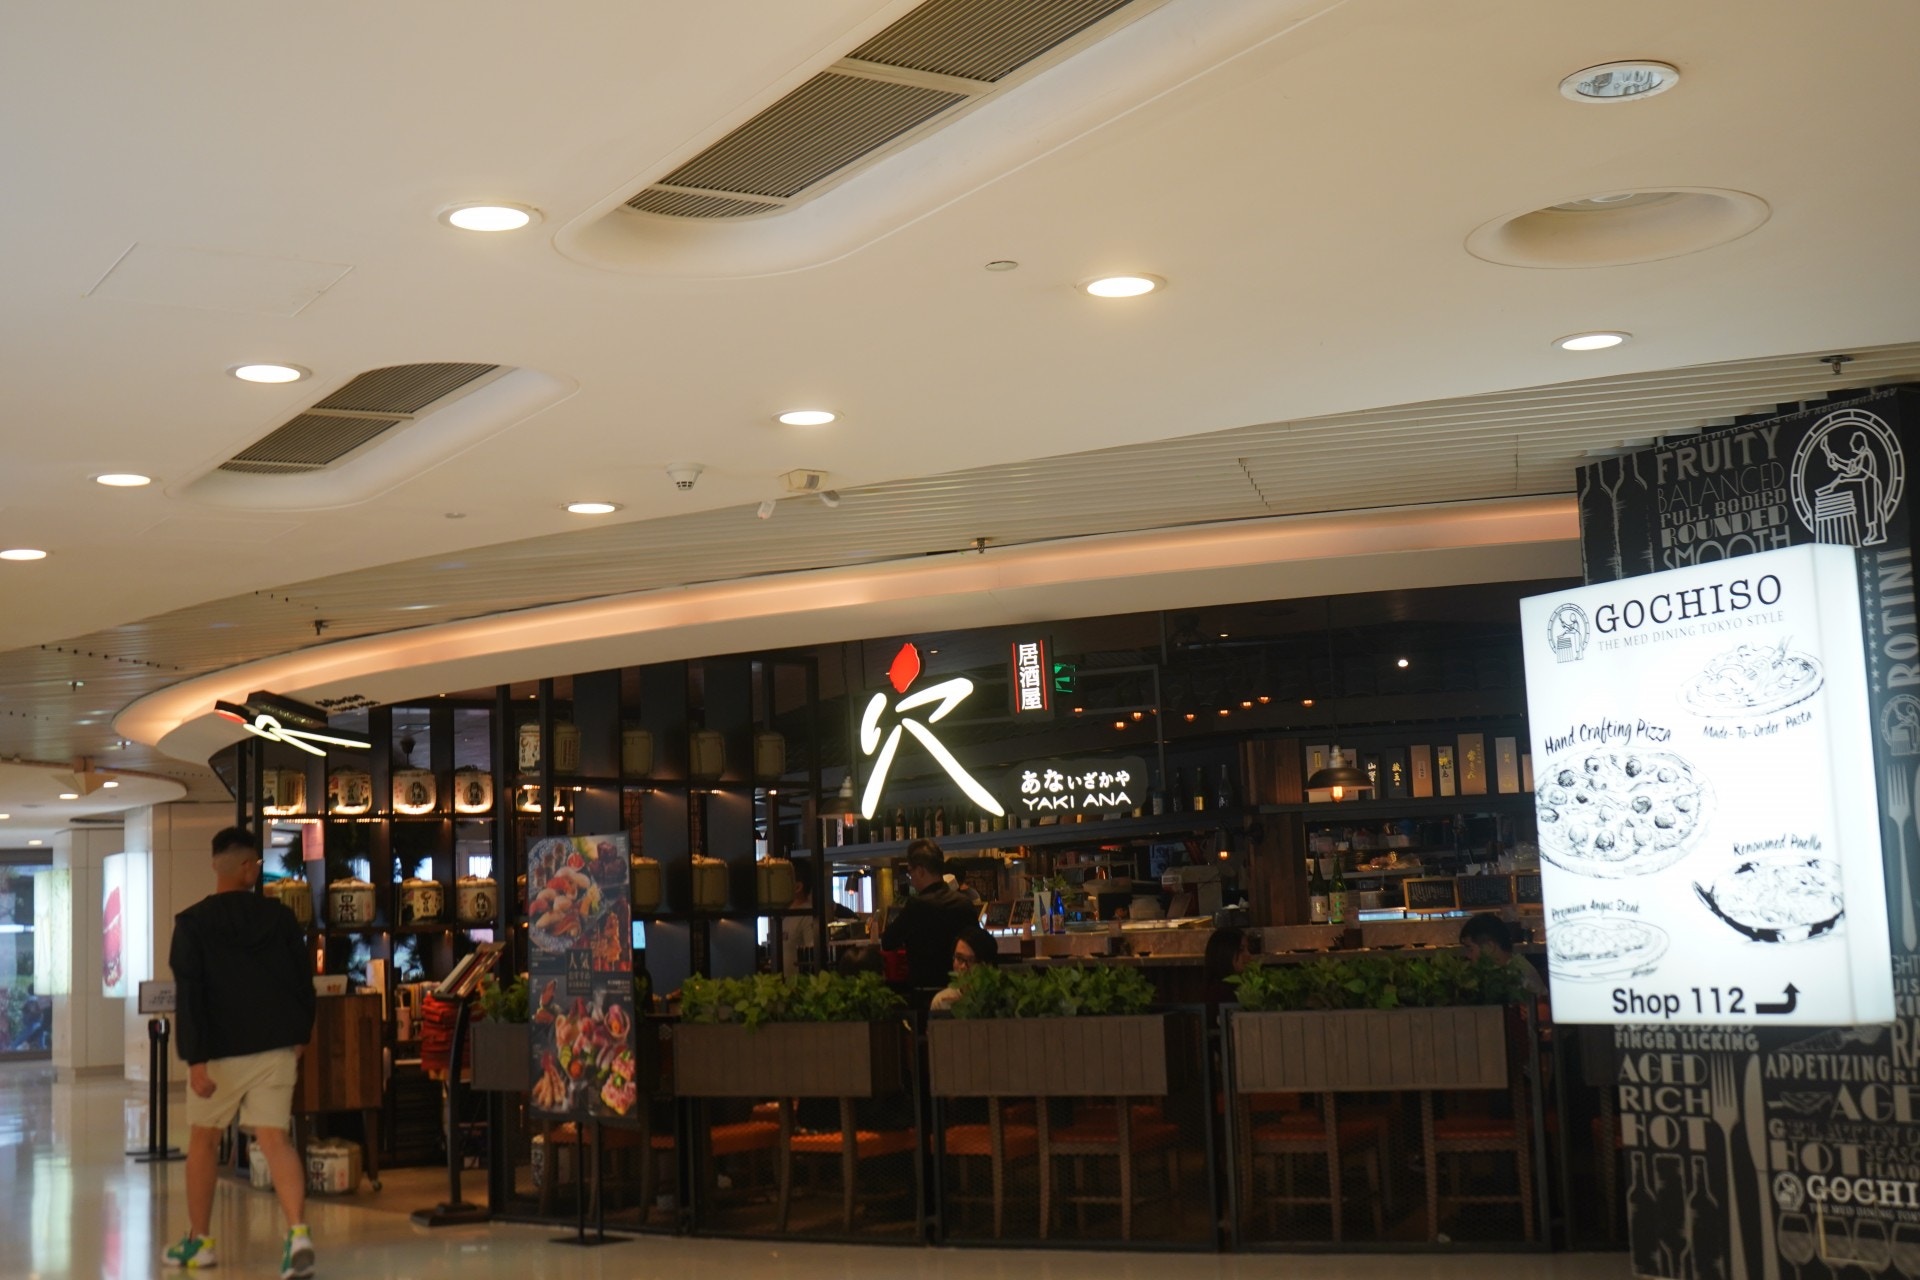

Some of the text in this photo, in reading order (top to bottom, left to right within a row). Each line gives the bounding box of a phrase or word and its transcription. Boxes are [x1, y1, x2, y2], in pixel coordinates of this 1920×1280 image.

[1656, 425, 1780, 485] FRUITY
[1657, 462, 1785, 513] BALANCED
[1660, 488, 1787, 528] FULL BODIED
[1661, 504, 1788, 548] ROUNDED
[1595, 574, 1781, 633] GOCHISO
[1598, 610, 1784, 651] THE MED DINING TOKYO STYLE
[1019, 643, 1042, 711] 居酒屋
[1545, 716, 1671, 756] Hand Crafting Pizza
[1786, 711, 1812, 728] Pasta
[1021, 769, 1131, 795] あないざかや
[1022, 791, 1132, 811] YAKI ANA
[1612, 987, 1746, 1019] Shop 112
[1614, 1031, 1760, 1051] FINGER LICKING
[1619, 1053, 1708, 1085] AGED
[1766, 1054, 1891, 1082] APPETIZING
[1619, 1085, 1711, 1115] RICH
[1620, 1113, 1711, 1151] HOT
[1770, 1139, 1866, 1177] HOT
